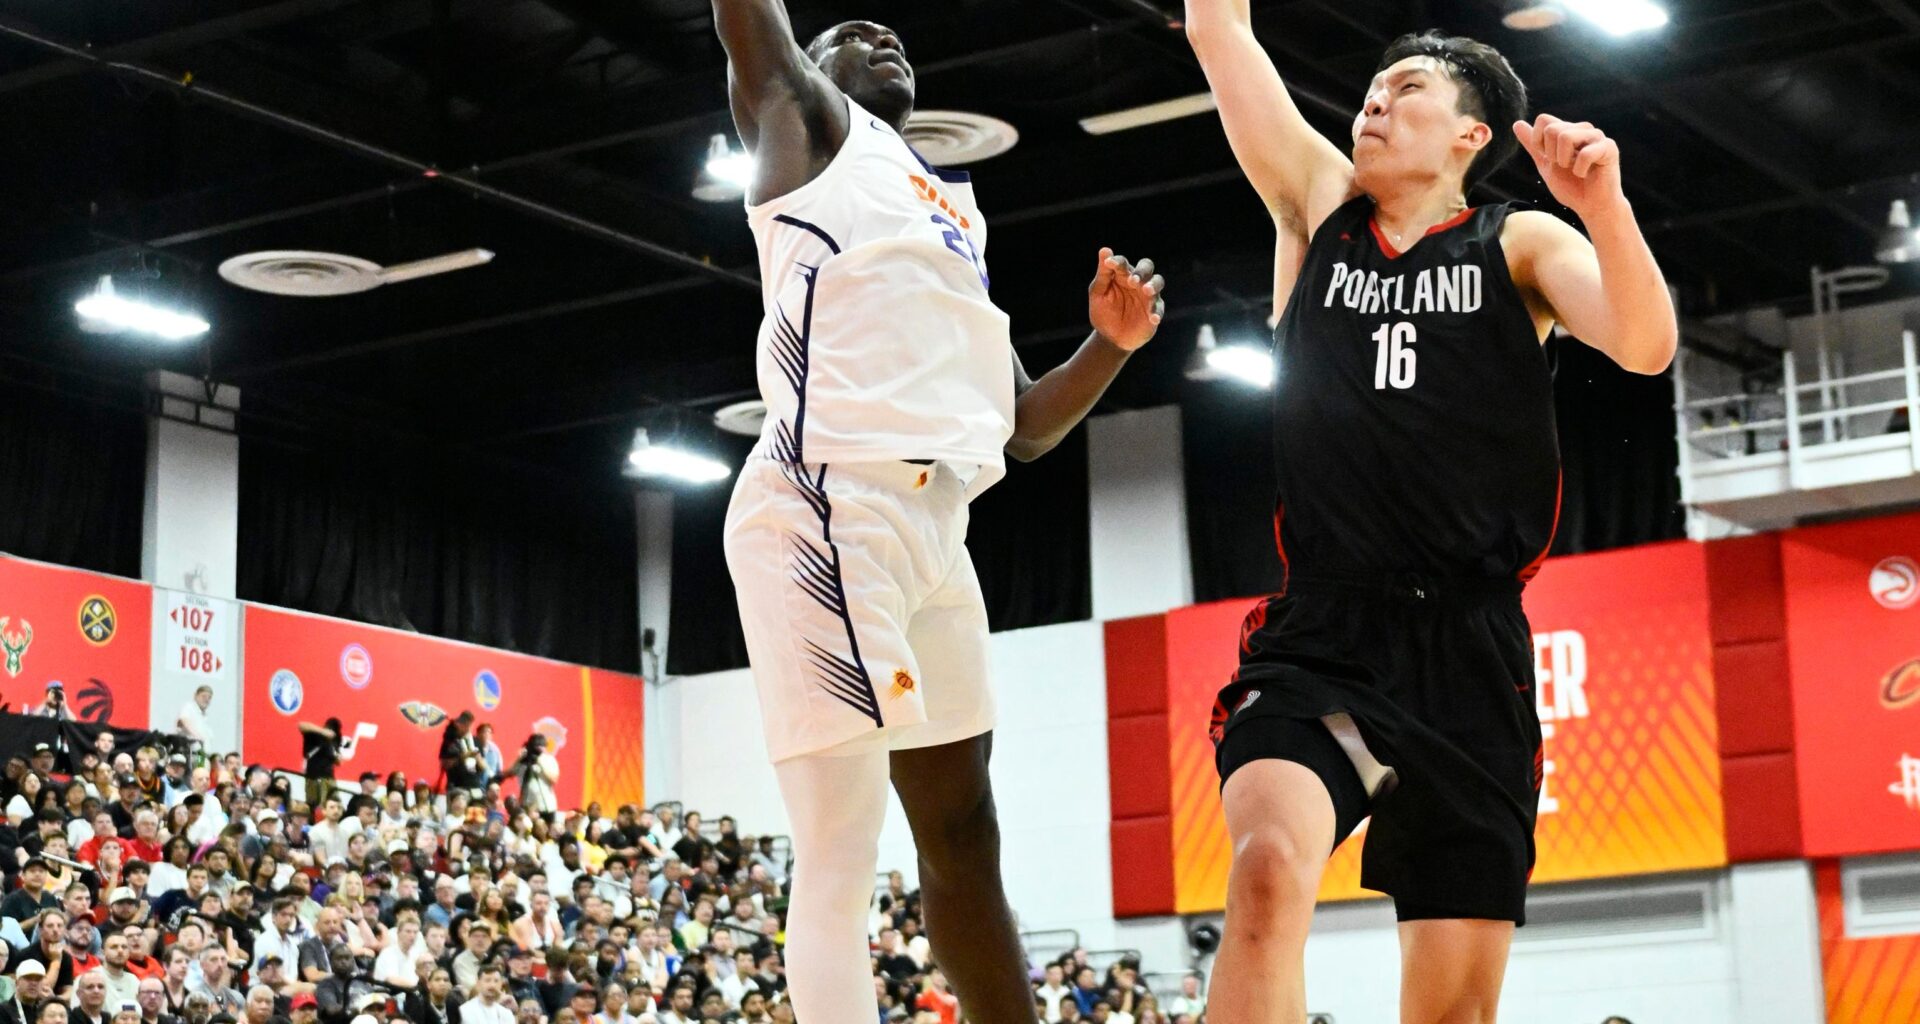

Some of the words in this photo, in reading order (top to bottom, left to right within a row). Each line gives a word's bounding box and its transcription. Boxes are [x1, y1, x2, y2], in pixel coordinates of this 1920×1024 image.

[1323, 261, 1482, 315] PORTLAND
[1371, 321, 1417, 390] 16
[181, 605, 214, 632] 107
[180, 645, 213, 673] 108
